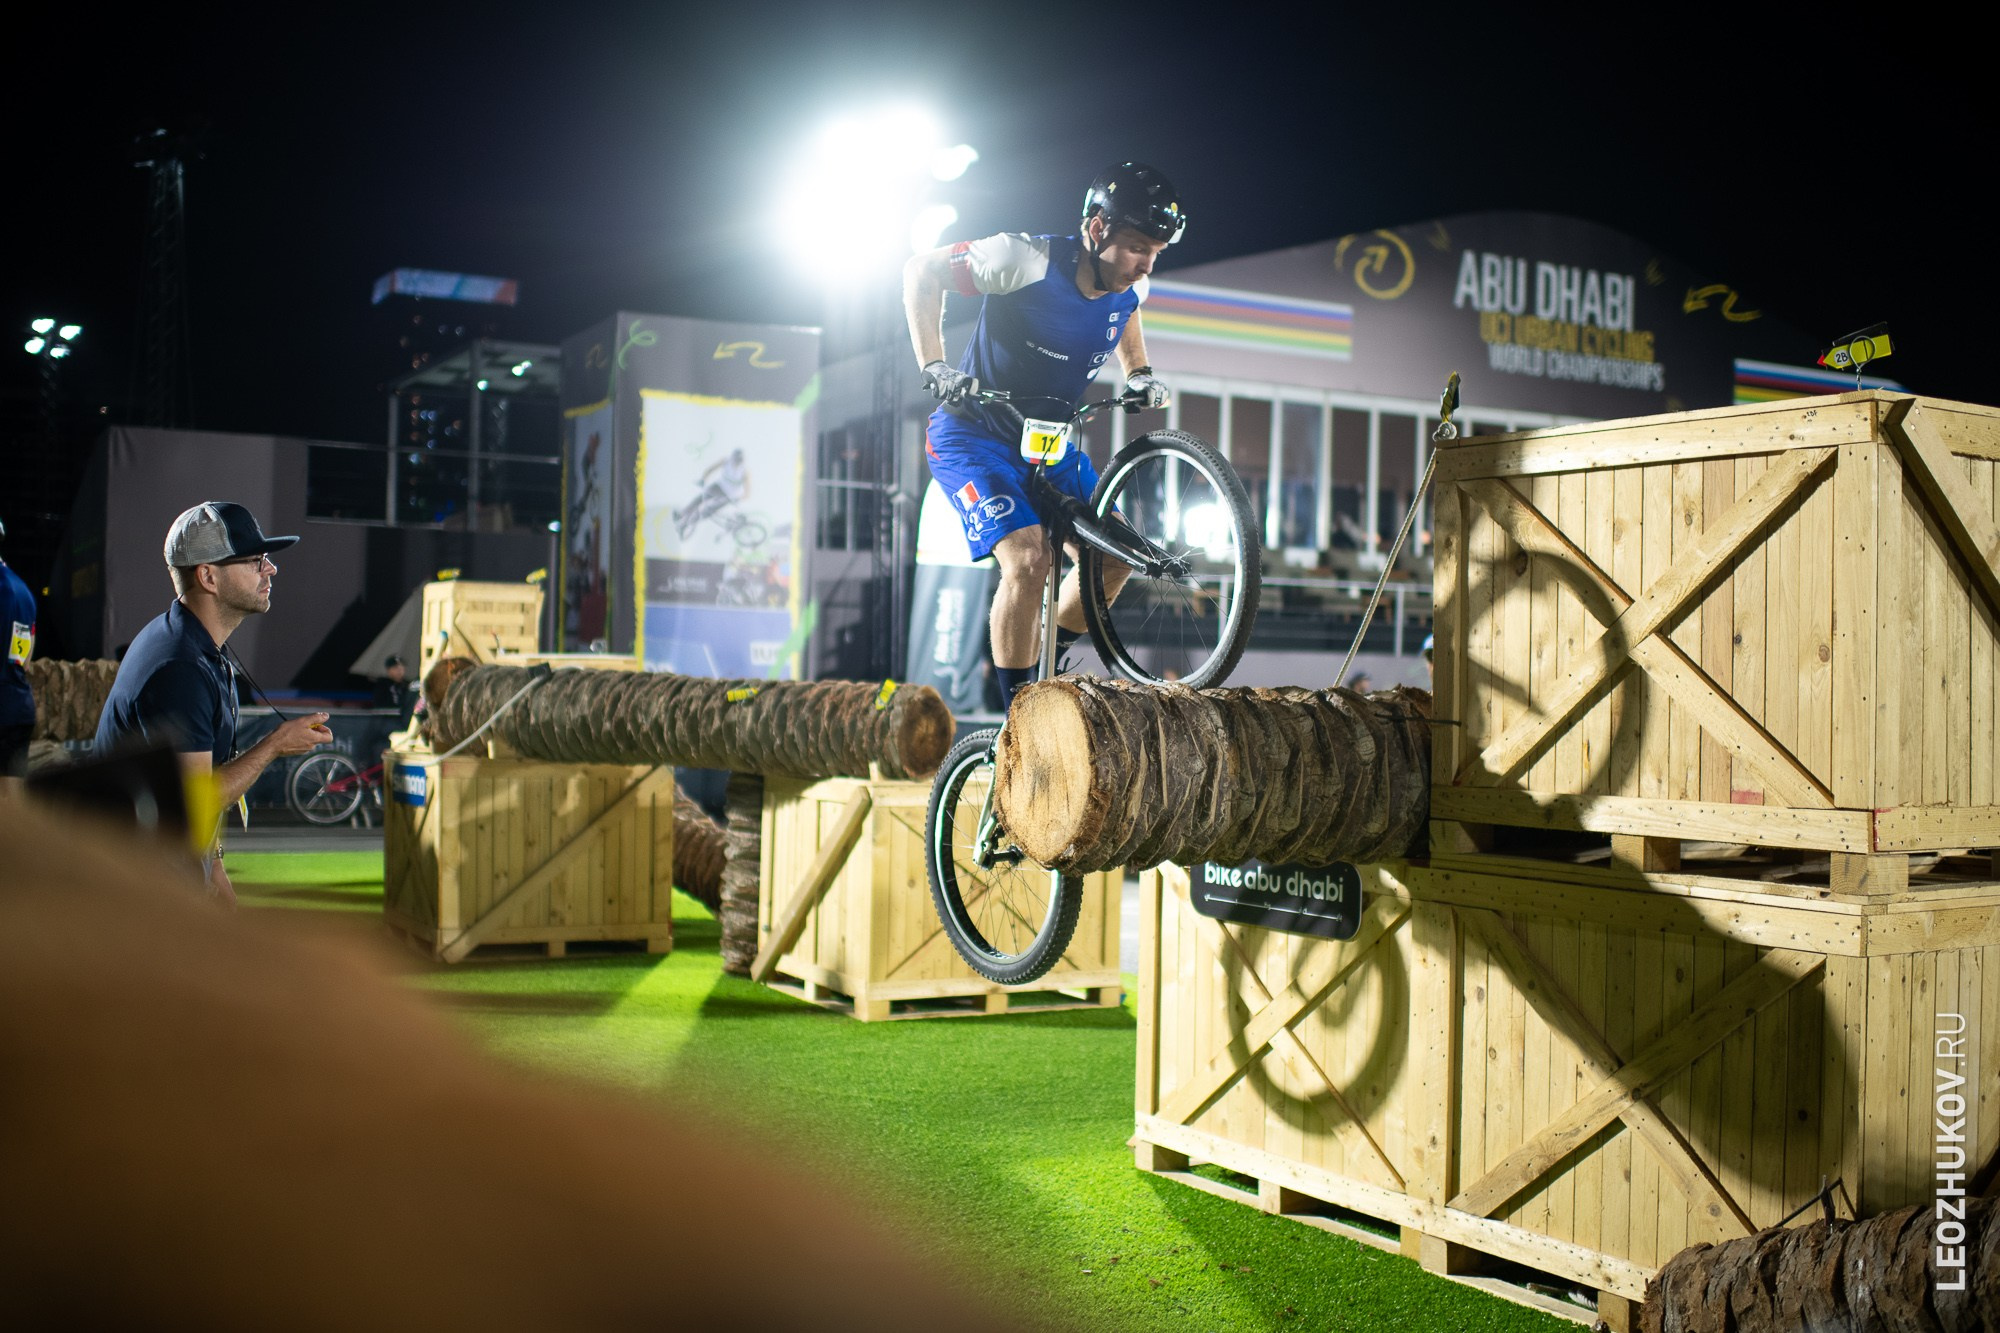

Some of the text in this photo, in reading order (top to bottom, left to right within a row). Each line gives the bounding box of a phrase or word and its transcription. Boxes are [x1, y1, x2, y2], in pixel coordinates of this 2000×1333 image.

[1454, 250, 1635, 332] ABU DHABI
[1487, 342, 1665, 392] WORLD CHAMPIONSHIPS
[1835, 352, 1849, 363] 2B
[1041, 436, 1055, 452] 11
[1204, 860, 1343, 902] bike abu dhabi
